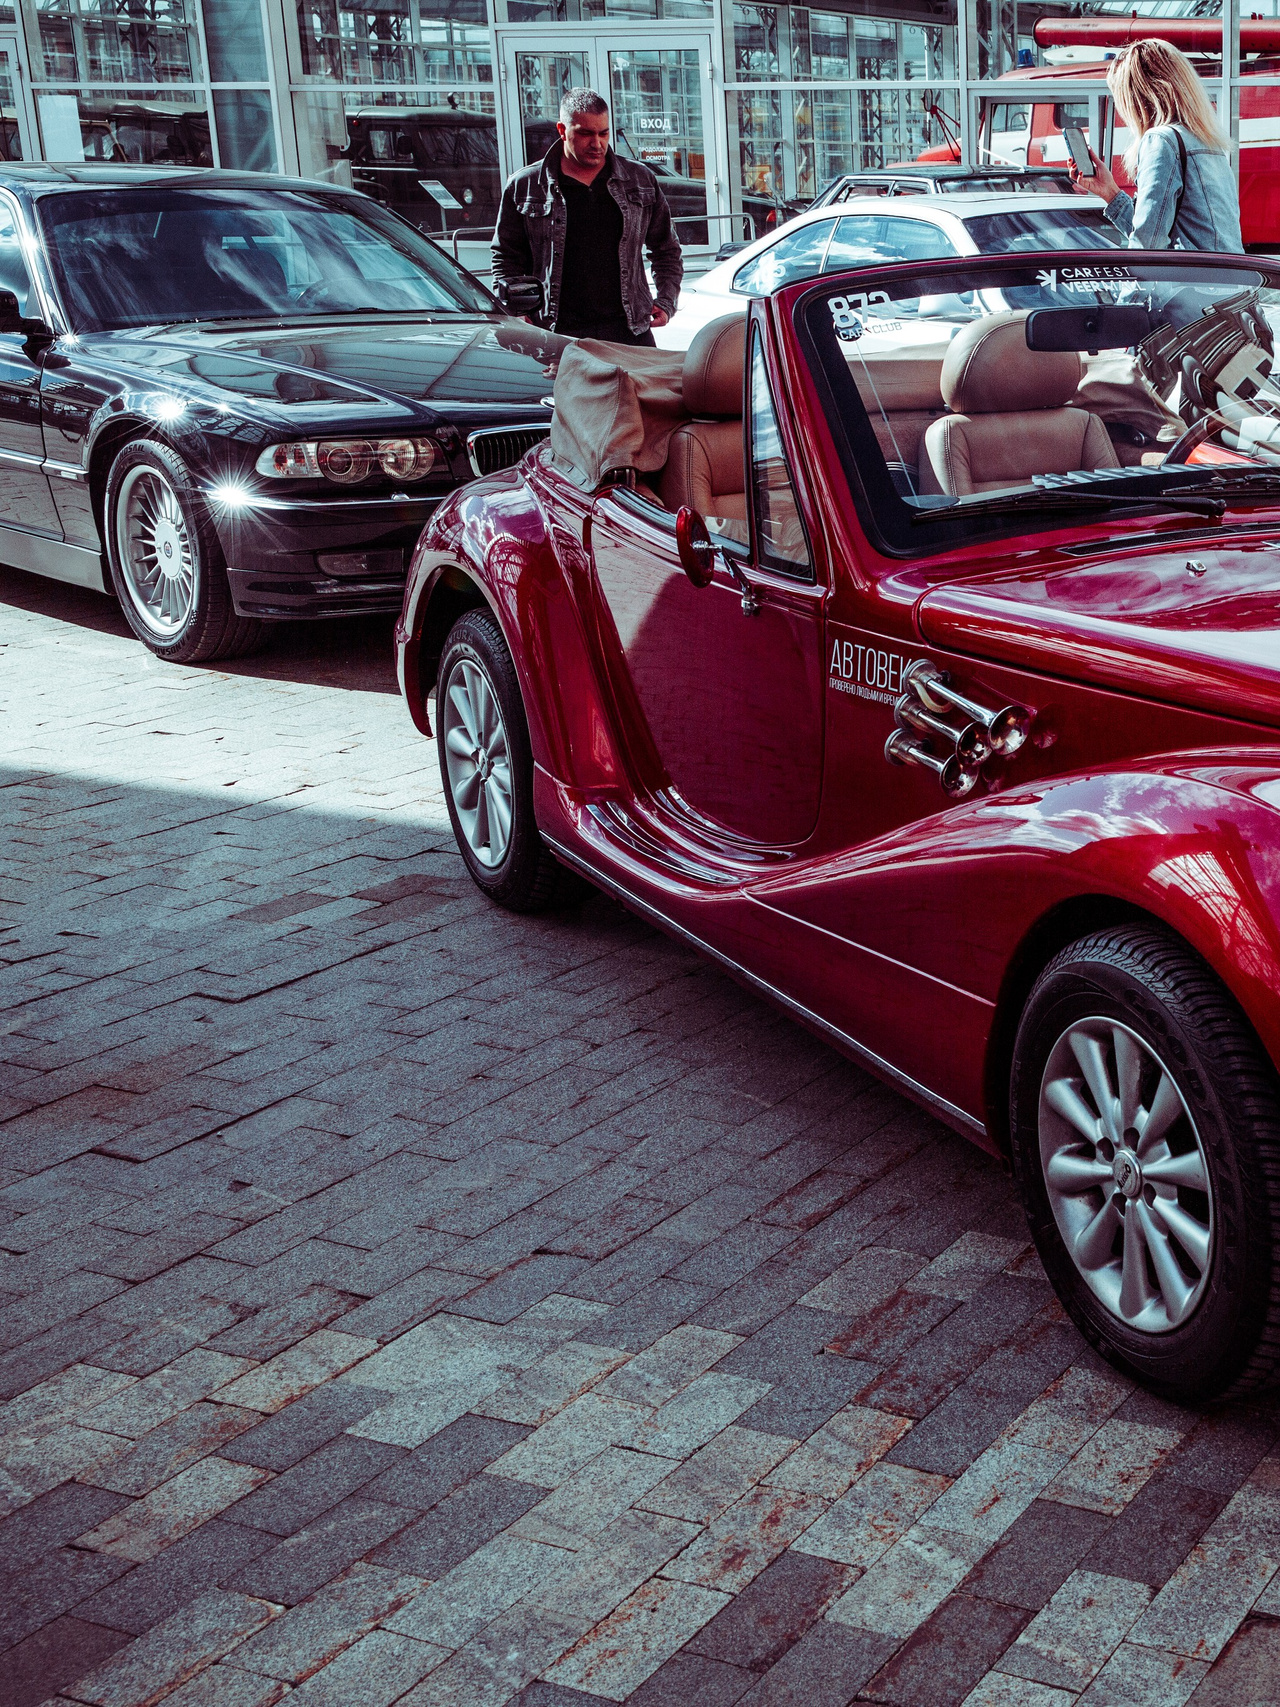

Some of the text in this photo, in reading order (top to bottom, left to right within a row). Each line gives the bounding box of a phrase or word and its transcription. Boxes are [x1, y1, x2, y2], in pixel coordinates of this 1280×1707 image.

[640, 118, 671, 130] ВХОД
[839, 321, 903, 340] CAR CLUB
[829, 677, 856, 695] ПРОВЕРЕНО
[856, 685, 879, 702] ЛЮДЬМИ
